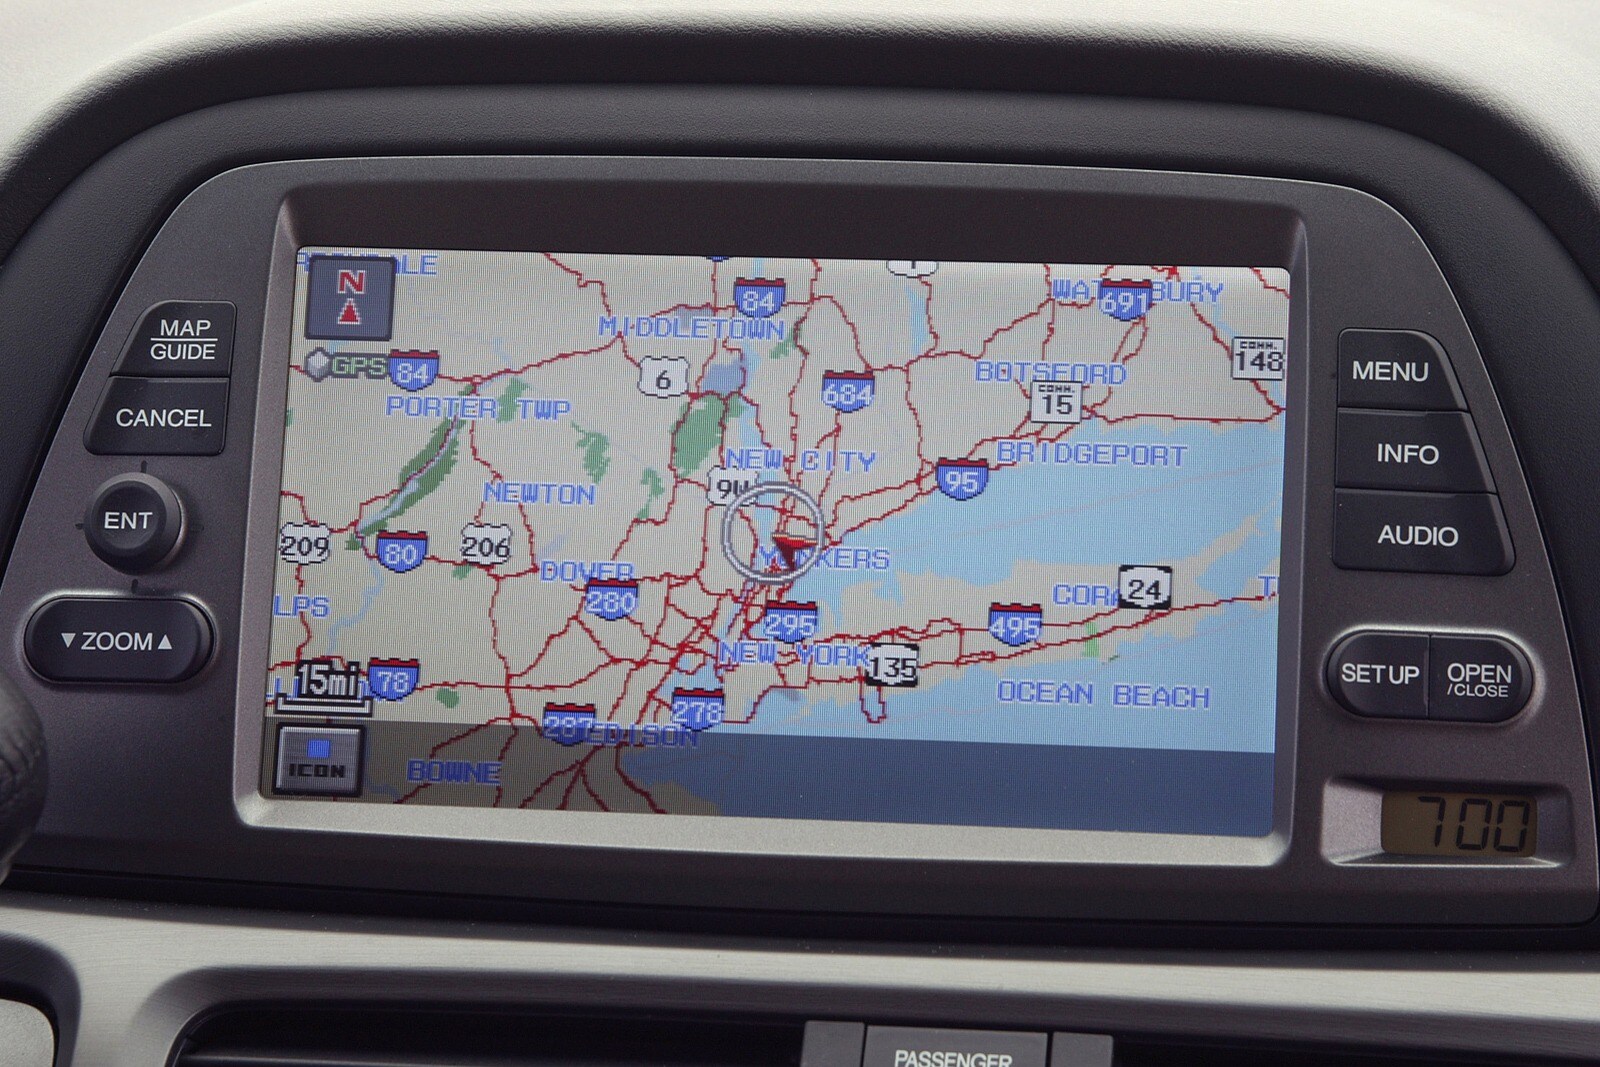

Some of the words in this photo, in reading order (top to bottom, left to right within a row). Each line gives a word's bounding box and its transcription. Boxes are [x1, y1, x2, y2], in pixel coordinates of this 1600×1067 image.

[339, 270, 365, 294] N
[1053, 278, 1224, 303] WATBURY
[743, 291, 775, 312] 84
[1101, 293, 1147, 313] 691
[160, 319, 211, 336] MAP
[599, 316, 785, 340] MIDDLETOWN
[150, 344, 216, 360] GUIDE
[1236, 351, 1283, 371] 148
[332, 357, 386, 375] GPS
[397, 363, 428, 383] 84
[976, 361, 1128, 384] BOTSFORD
[1352, 360, 1429, 382] MENU
[656, 371, 671, 390] 6
[823, 384, 872, 405] 684
[1042, 395, 1072, 414] 15
[116, 408, 212, 428] CANCEL
[386, 397, 497, 418] PORTER
[516, 398, 570, 420] TWP
[727, 449, 781, 470] NEW
[801, 451, 876, 473] CITY
[998, 441, 1188, 469] BRIDGEPORT
[1377, 443, 1439, 465] INFO
[946, 472, 978, 492] 95
[484, 482, 596, 504] NEWTON
[104, 512, 153, 529] ENT
[281, 537, 330, 556] 209
[1378, 525, 1459, 547] AUDIO
[386, 544, 416, 564] 80
[462, 537, 512, 557] 206
[1128, 579, 1161, 600] 24
[587, 592, 635, 613] 280
[765, 614, 816, 636] 295
[988, 617, 1040, 640] 495
[81, 632, 153, 651] ZOOM
[719, 641, 777, 663] NEW
[797, 645, 870, 667] YORK
[872, 657, 917, 677] 135
[1447, 663, 1511, 683] OPEN
[298, 662, 357, 696] 15mi
[378, 671, 408, 692] 78
[998, 681, 1092, 704] OCEAN
[1114, 684, 1209, 708] BEACH
[1447, 684, 1509, 697] /CLOSE
[672, 702, 721, 723] 278
[544, 717, 592, 737] 287
[588, 722, 697, 747] EDISON
[289, 764, 344, 777] ICON
[407, 760, 501, 784] BOWNE
[1417, 796, 1530, 852] 700
[895, 1049, 1013, 1067] PASSENGER
